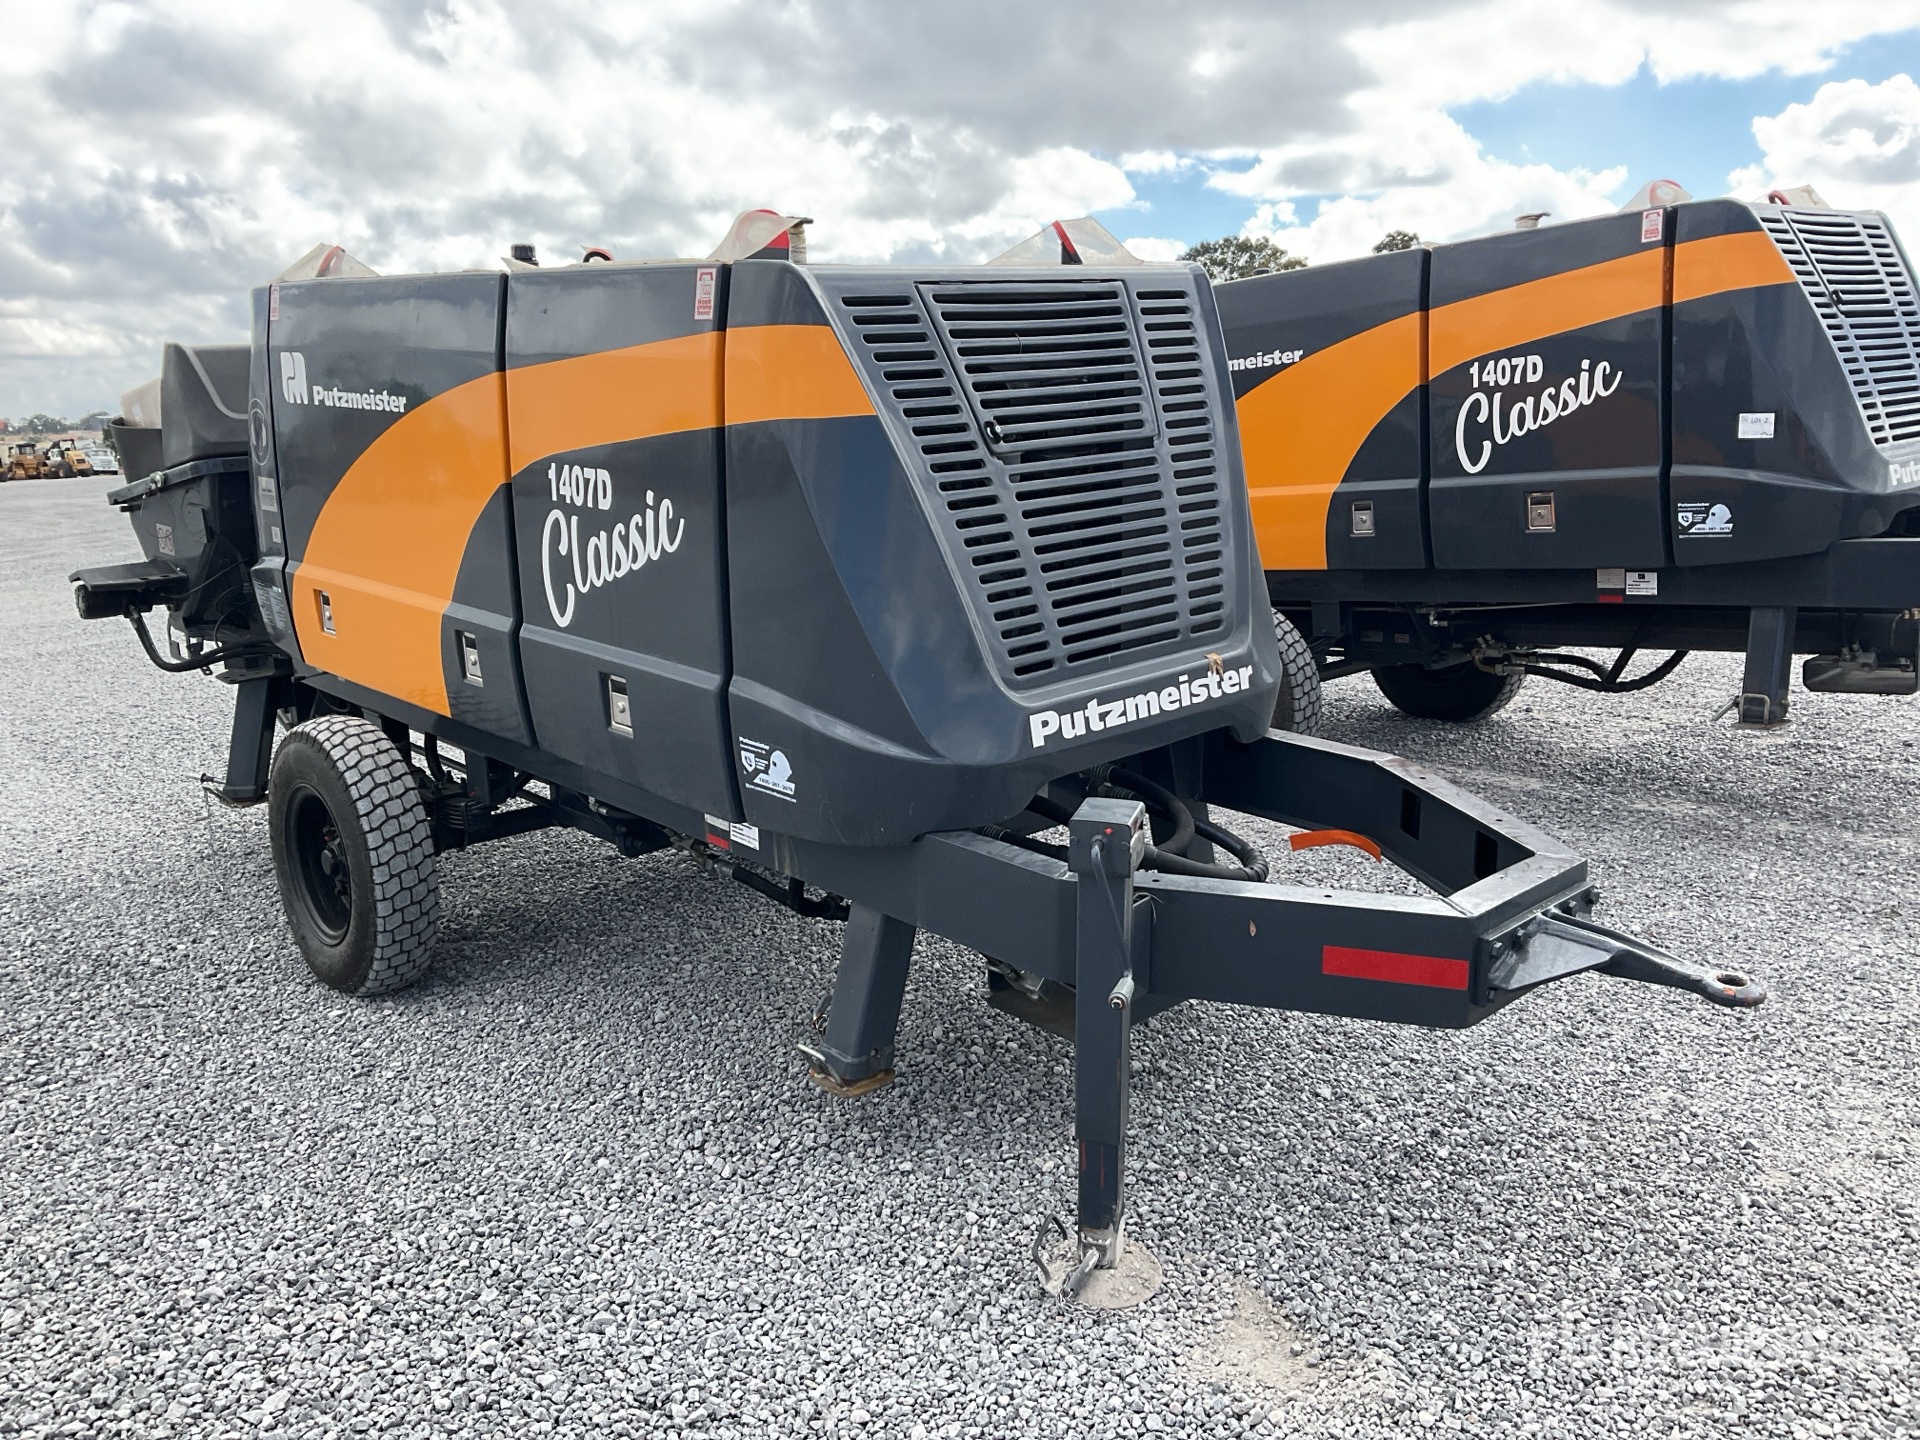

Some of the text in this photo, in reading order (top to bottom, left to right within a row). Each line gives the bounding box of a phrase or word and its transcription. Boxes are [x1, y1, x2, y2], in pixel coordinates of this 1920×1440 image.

[312, 385, 407, 413] Putzmeister
[1469, 354, 1544, 389] 1407D
[1455, 358, 1623, 474] Classic
[548, 462, 612, 511] 1407D
[541, 489, 685, 628] Classic
[1029, 664, 1254, 749] Putzmeister
